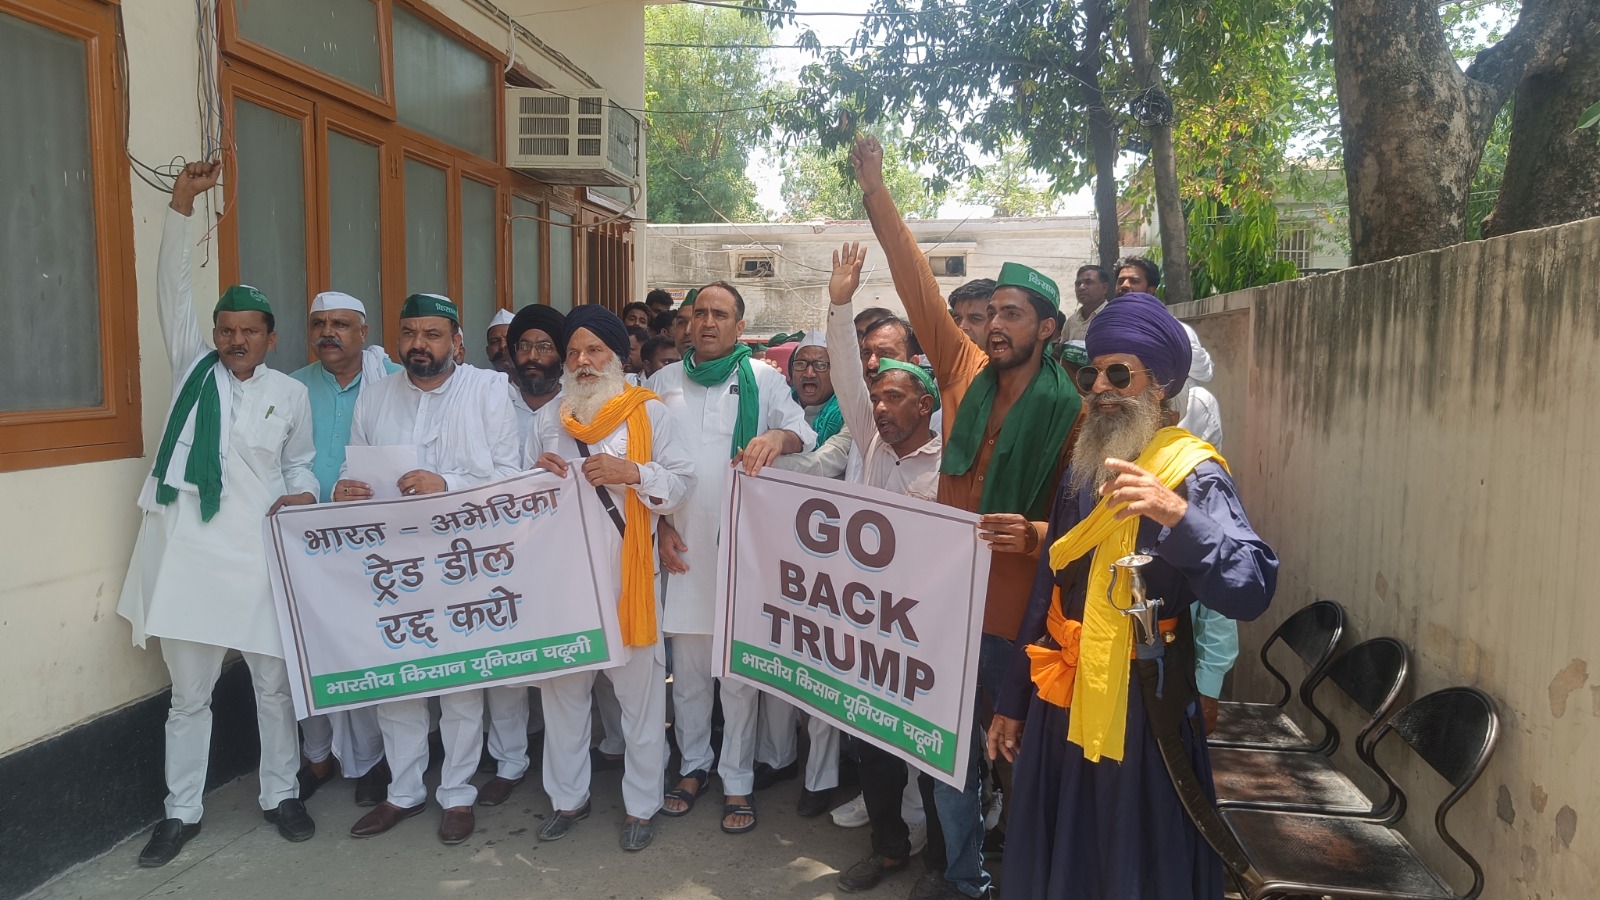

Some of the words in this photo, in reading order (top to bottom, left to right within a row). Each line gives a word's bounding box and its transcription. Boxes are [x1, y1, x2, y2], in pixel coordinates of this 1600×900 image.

[303, 522, 387, 554] भारत
[430, 487, 561, 535] अमेरिका
[795, 497, 897, 572] GO
[362, 553, 425, 607] ट्रेड
[435, 537, 515, 585] डील
[779, 559, 920, 647] BACK
[376, 608, 439, 649] रद्द
[445, 585, 522, 637] करो
[326, 671, 395, 695] भारतीय
[399, 664, 466, 684] किसान
[470, 648, 538, 677] यूनियन
[542, 636, 591, 664] चढूनी
[761, 602, 936, 706] TRUMP
[741, 651, 793, 682] भारतीय
[795, 666, 841, 704] किसान
[843, 694, 899, 732] यूनियन
[902, 720, 944, 755] चढूनी
